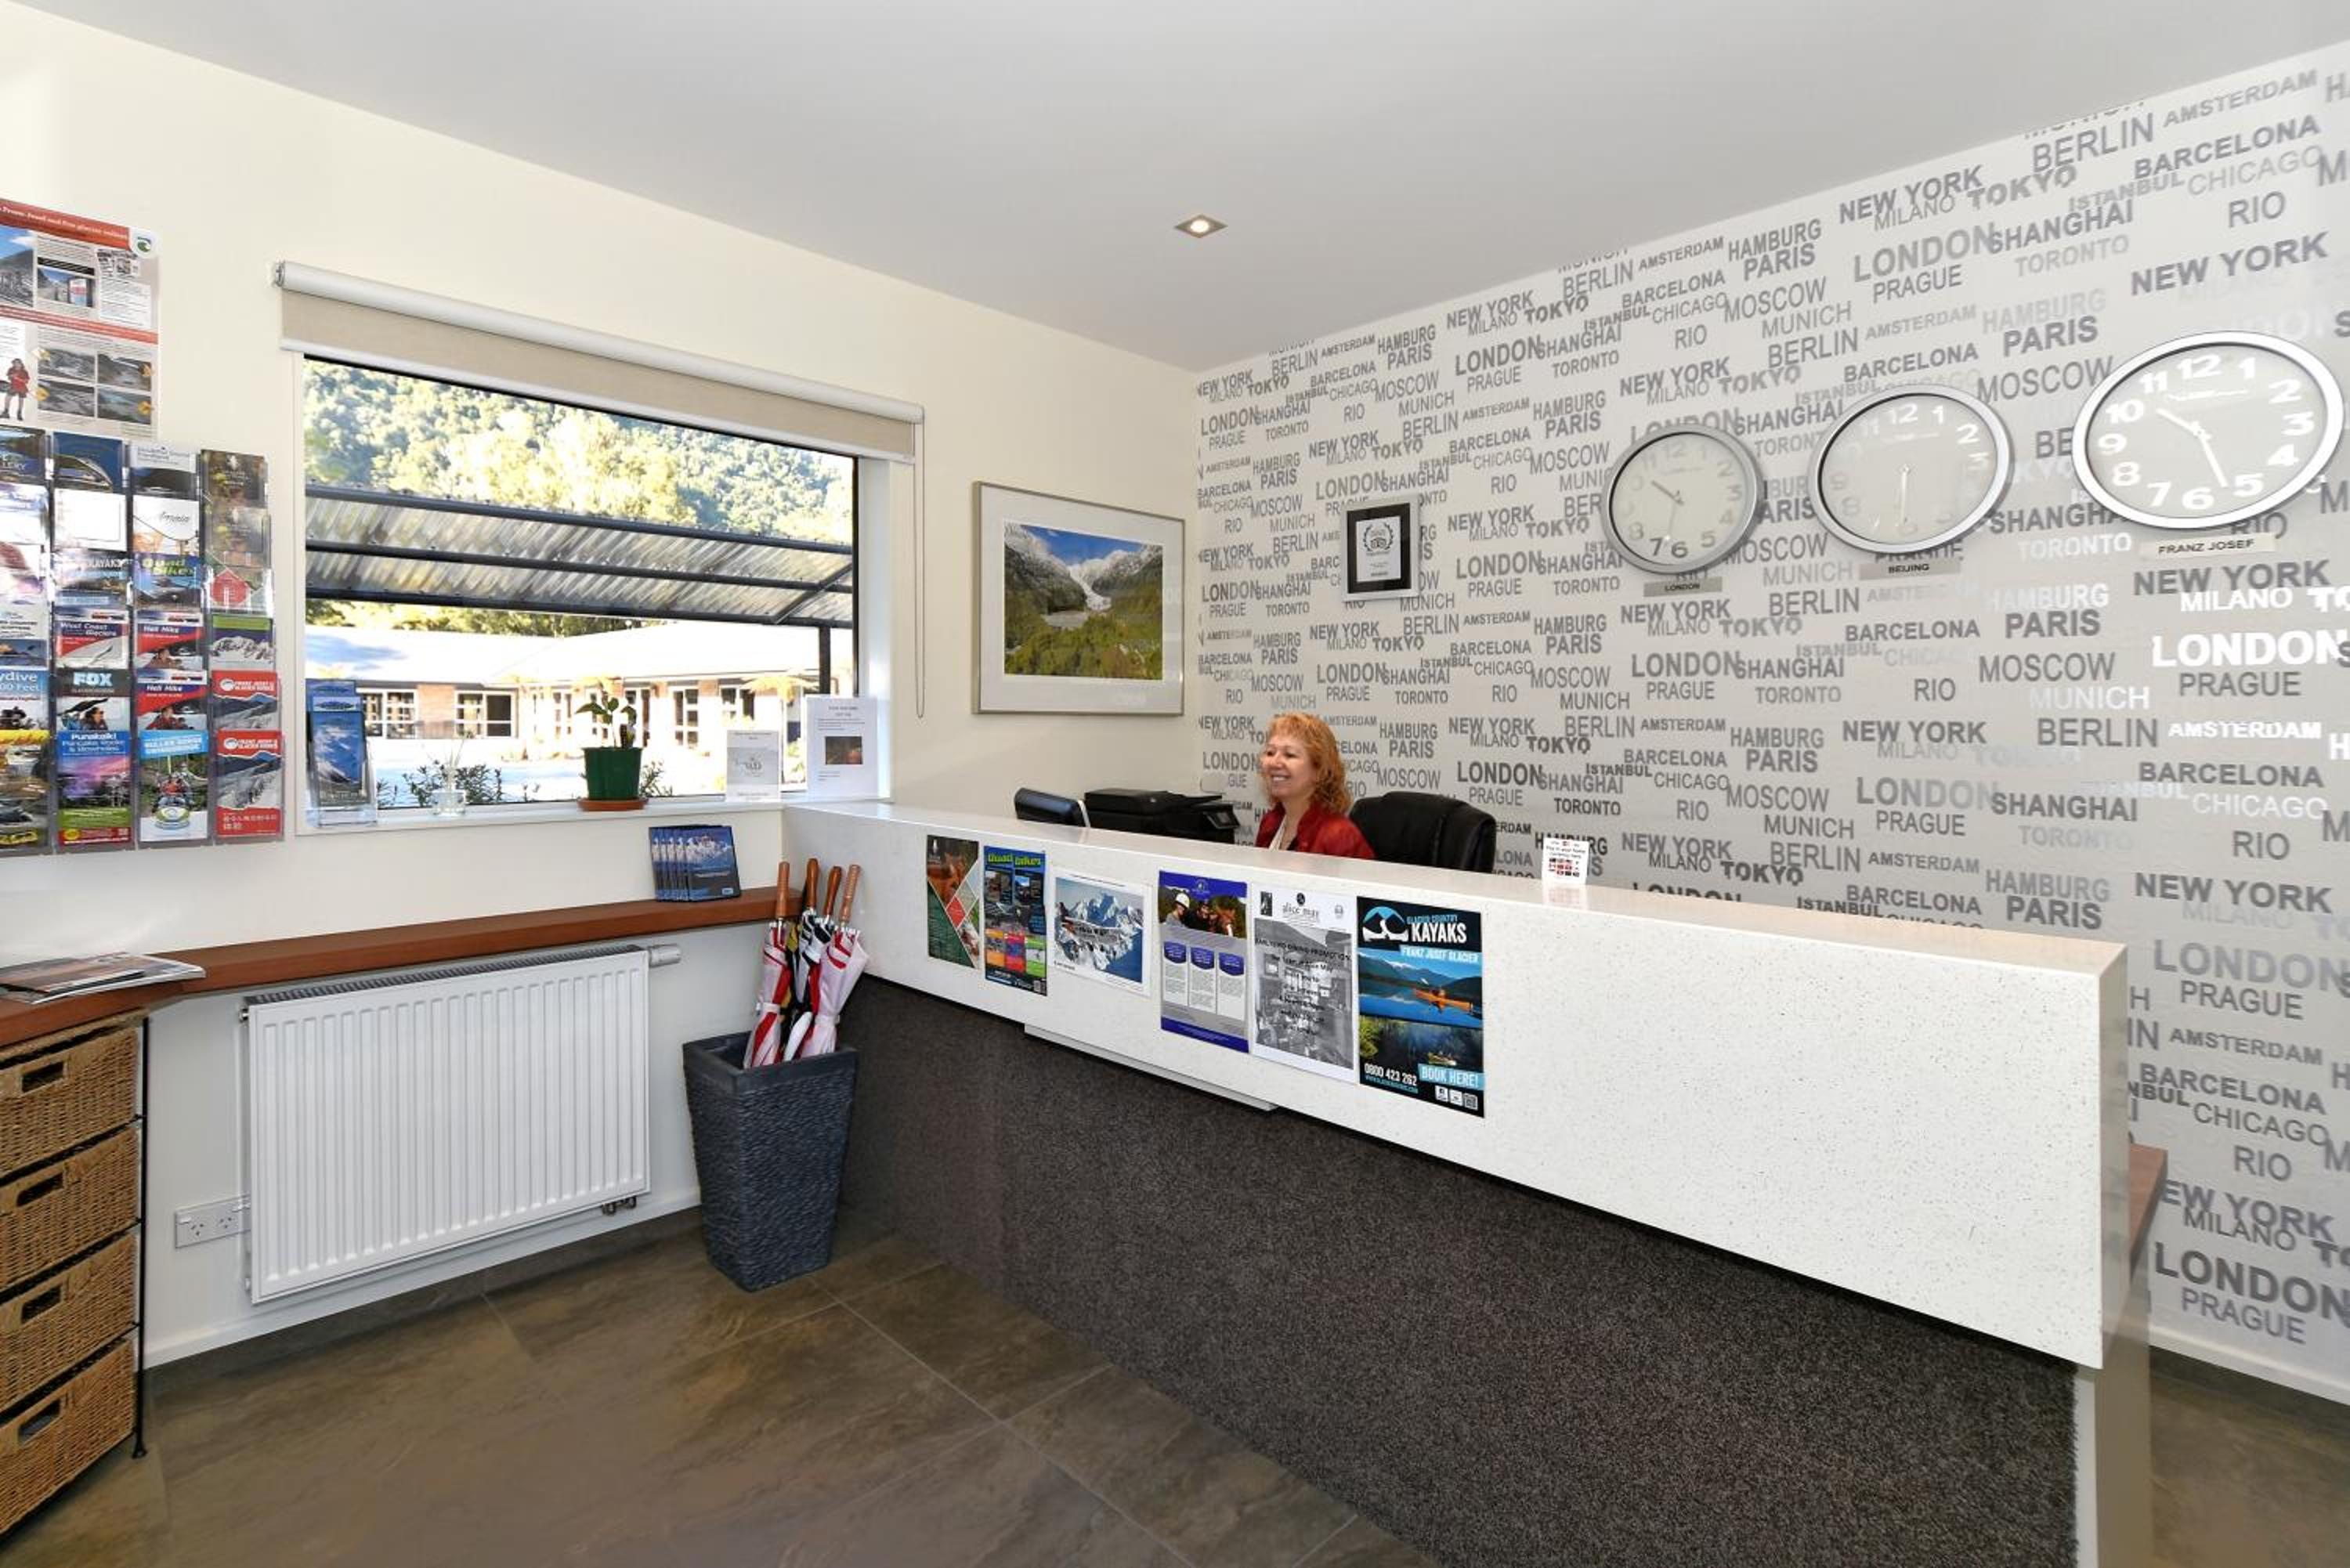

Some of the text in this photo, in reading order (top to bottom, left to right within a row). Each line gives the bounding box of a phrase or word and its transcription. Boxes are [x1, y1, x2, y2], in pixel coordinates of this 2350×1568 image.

[2163, 69, 2317, 128] AMSTERDAM
[2034, 113, 2153, 173] BERLIN
[2135, 114, 2320, 179] BARCELONA
[2188, 145, 2322, 195] CHICAGO
[1840, 165, 1983, 224] NEW YORK
[1967, 165, 2076, 209] TOKYO
[2228, 191, 2285, 227] RIO
[1990, 199, 2133, 255] SHANGHAI
[1639, 236, 1723, 271] AMSTERDAM
[1729, 219, 1821, 262] HAMBURG
[1854, 222, 1994, 282] LONDON
[1744, 243, 1816, 281] PARIS
[2131, 232, 2328, 296] NEW YORK
[1563, 259, 1633, 298] BERLIN
[1622, 269, 1726, 309] BARCELONA
[1873, 265, 1962, 303] PRAGUE
[1448, 290, 1534, 330] NEW YORK
[1524, 295, 1589, 324] TOKYO
[1725, 276, 1826, 323] MOSCOW
[1378, 323, 1436, 354] HAMBURG
[1537, 325, 1622, 359] SHANGHAI
[1675, 324, 1707, 349] RIO
[1769, 327, 1857, 368] BERLIN
[2004, 316, 2098, 356] PARIS
[1271, 349, 1318, 377] BERLIN
[1387, 343, 1432, 370] PARIS
[1455, 334, 1541, 375] LONDON
[1553, 350, 1619, 378] TORONTO
[1844, 343, 1979, 383] BARCELONA
[2177, 355, 2222, 379] 12
[2240, 357, 2255, 378] 1
[1247, 374, 1289, 396] TOKYO
[1311, 361, 1376, 388] BARCELONA
[1375, 370, 1439, 402] MOSCOW
[1467, 366, 1521, 393] PRAGUE
[2140, 370, 2167, 394] 11
[1329, 379, 1377, 401] CHICAGO
[2269, 379, 2301, 403] 2
[1343, 403, 1365, 422] RIO
[1398, 391, 1455, 417] MUNICH
[1462, 398, 1529, 421] AMSTERDAM
[1534, 391, 1605, 421] HAMBURG
[1888, 403, 1918, 425] 12
[1932, 406, 1944, 424] 1
[2106, 399, 2143, 424] 10
[1958, 423, 1979, 444] 2
[2282, 411, 2315, 436] 3
[1309, 431, 1379, 458] NEW YORK
[1449, 427, 1531, 453] BARCELONA
[2098, 433, 2127, 454] 9
[1530, 443, 1610, 475] MOSCOW
[2268, 445, 2299, 465] 4
[1315, 471, 1385, 500] LONDON
[1381, 468, 1448, 492] SHANGHAI
[1491, 475, 1516, 494] RIO
[2112, 461, 2141, 486] 8
[2233, 473, 2263, 497] 5
[2147, 482, 2171, 507] 7
[2182, 487, 2214, 510] 6
[1448, 504, 1534, 531] NEW YORK
[1629, 522, 1643, 540] 8
[1701, 530, 1716, 547] 5
[1650, 538, 1662, 557] 7
[1672, 542, 1687, 558] 6
[2159, 539, 2254, 555] FRANZ JOSEF
[1456, 551, 1542, 579] LONDON
[1889, 564, 1929, 573] BEIJING
[2134, 559, 2330, 595] NEW YORK
[1468, 578, 1522, 598] PRAGUE
[1665, 583, 1700, 591] LONDON
[2181, 587, 2293, 612] MILANO
[1770, 587, 1859, 616] BERLIN
[1310, 622, 1379, 640] NEW YORK
[1463, 611, 1531, 626] AMSTERDAM
[1846, 620, 1980, 641] BARCELONA
[2005, 609, 2101, 638] PARIS
[1261, 648, 1298, 665] PARIS
[1372, 637, 1424, 652] TOKYO
[1546, 634, 1603, 655] PARIS
[2153, 629, 2348, 667] LONDON
[1317, 663, 1386, 683] LONDON
[1474, 661, 1533, 676] CHICAGO
[1632, 651, 1740, 677] LONDON
[1737, 658, 1843, 678] SHANGHAI
[1979, 652, 2115, 683] MOSCOW
[73, 672, 113, 686] FOX
[1914, 678, 1955, 702] RIO
[2179, 672, 2301, 696] PRAGUE
[1326, 686, 1370, 702] PRAGUE
[1560, 692, 1630, 710] MUNICH
[1731, 727, 1824, 749] HAMBURG
[2037, 717, 2158, 747] BERLIN
[2168, 721, 2322, 739] AMSTERDAM
[1527, 736, 1591, 754] TOKYO
[1457, 761, 1542, 786] LONDON
[1586, 764, 1652, 777] ISTANBUL
[2138, 761, 2325, 788] BARCELONA
[1554, 798, 1621, 815] TORONTO
[1726, 785, 1828, 812] MOSCOW
[1990, 792, 2138, 822] SHANGHAI
[2193, 793, 2327, 820] CHICAGO
[1764, 815, 1854, 839] MUNICH
[1876, 810, 1965, 836] PRAGUE
[2232, 830, 2290, 860] RIO
[1868, 852, 1979, 874] AMSTERDAM
[2135, 873, 2332, 914] NEW YORK
[2007, 896, 2101, 930] PARIS
[1412, 922, 1467, 943] KAYAKS
[2169, 1028, 2322, 1065] AMSTERDAM
[1365, 1063, 1383, 1076] 0800
[1386, 1068, 1401, 1081] 423
[1422, 1067, 1478, 1087] BOOK HERE!
[2140, 1063, 2327, 1115] BARCELONA
[2194, 1102, 2330, 1147] CHICAGO
[2182, 1287, 2306, 1345] PRAGUE
